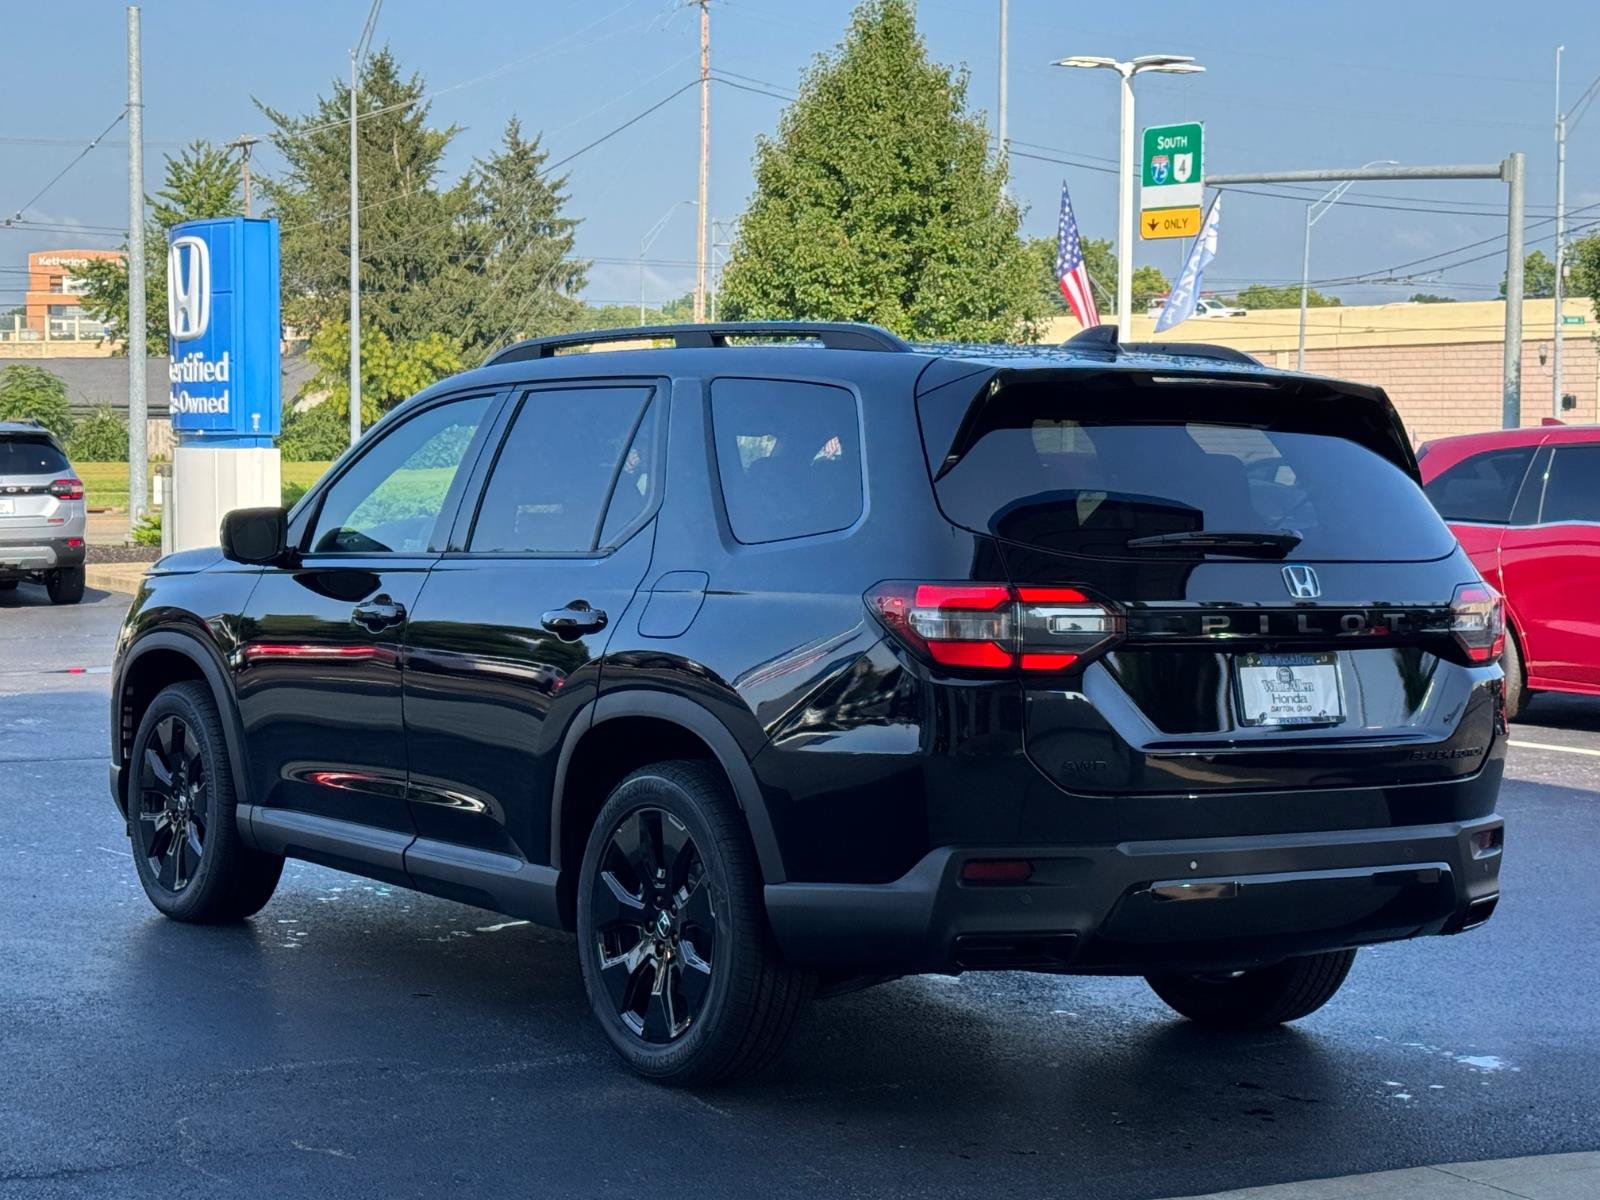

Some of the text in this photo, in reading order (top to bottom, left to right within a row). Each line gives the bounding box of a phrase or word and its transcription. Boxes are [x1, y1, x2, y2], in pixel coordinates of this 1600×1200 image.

[1152, 163, 1168, 179] 75
[1178, 159, 1187, 176] 4
[1163, 217, 1189, 230] ONLY
[38, 256, 88, 267] Kettering
[1201, 613, 1406, 635] PILOT
[1271, 692, 1308, 704] Honda
[1270, 704, 1313, 713] DAYTON, OHIO
